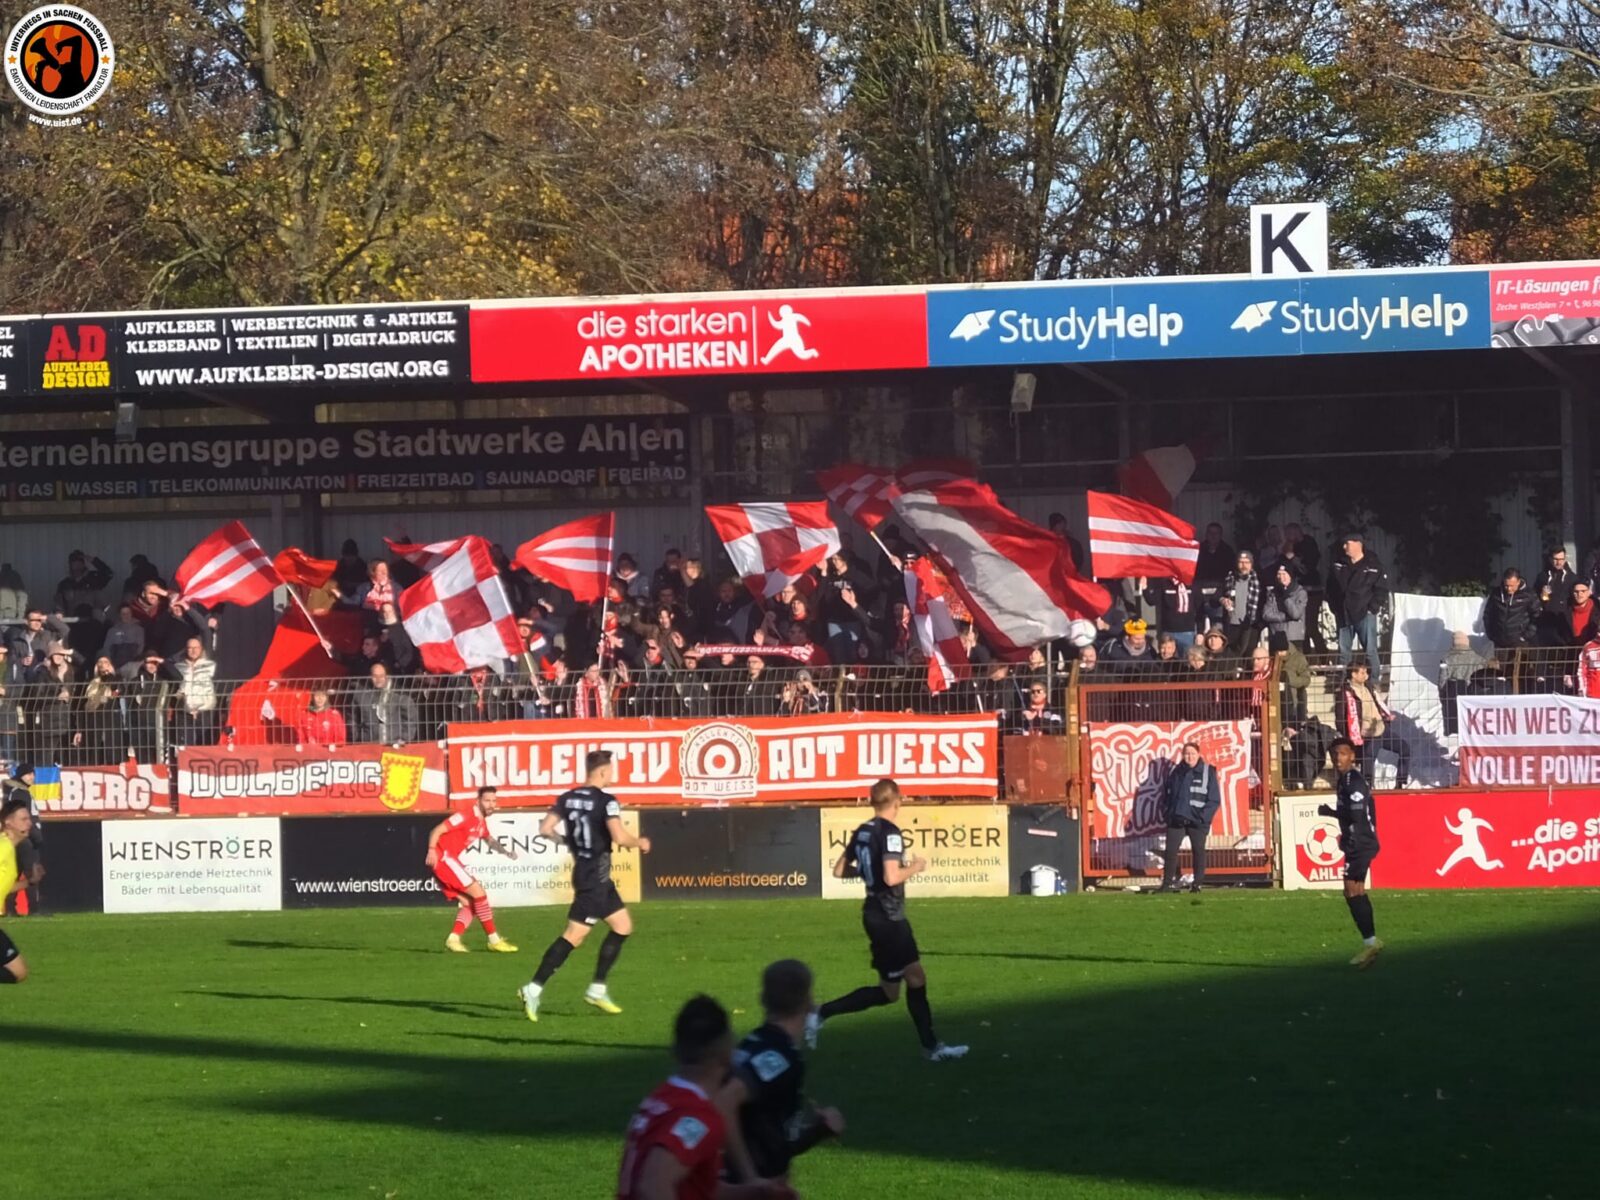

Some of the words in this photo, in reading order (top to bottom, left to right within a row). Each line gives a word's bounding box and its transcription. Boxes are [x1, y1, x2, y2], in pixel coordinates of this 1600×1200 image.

[1260, 211, 1314, 274] K
[1495, 279, 1590, 296] IT-Lösungen
[1592, 275, 1600, 294] f
[124, 319, 216, 335] AUFKLEBER
[231, 315, 358, 332] WERBETECHNIK
[362, 314, 375, 327] &
[379, 311, 457, 327] -ARTIKEL
[577, 310, 627, 339] die
[634, 307, 748, 337] starken
[999, 303, 1184, 350] StudyHelp
[1280, 293, 1468, 340] StudyHelp
[45, 324, 107, 361] AD
[126, 338, 221, 354] KLEBEBAND
[234, 334, 318, 350] TEXTILIEN
[332, 330, 456, 347] DIGITALDRUCK
[43, 361, 109, 372] AUFKLEBER
[578, 340, 748, 372] APOTHEKEN
[42, 371, 110, 389] DESIGN
[135, 360, 450, 386] WWW.AUFKLEBER-DESIGN.ORG
[352, 426, 565, 458] Stadtwerke
[578, 422, 685, 453] Ahlen
[18, 482, 54, 497] GAS
[65, 481, 138, 496] WASSER
[150, 475, 345, 494] TELEKOMMUNIKATION
[358, 471, 475, 488] FREIZEITBAD
[486, 468, 597, 486] SAUNADORF
[607, 466, 686, 484] FREIBAD
[1467, 708, 1517, 735] KEIN
[1524, 707, 1572, 735] WEG
[768, 735, 845, 780] ROT
[857, 732, 985, 775] WEISS
[189, 758, 383, 798] DOLBERG
[1467, 755, 1535, 785] VOLLE
[40, 771, 150, 811] BERG
[714, 780, 754, 791] WEISS
[829, 825, 1000, 850] WSTRÖER
[1584, 816, 1600, 837] s
[109, 836, 272, 861] WIENSTRÖER
[109, 869, 203, 881] Energiesparende
[206, 867, 272, 879] Heiztechnik
[931, 856, 1001, 868] Heiztechnik
[1309, 867, 1344, 880] AHLE
[157, 884, 175, 895] mit
[179, 883, 262, 896] Lebensqualität
[513, 879, 530, 889] mit
[655, 871, 807, 888] www.wienstroeer.de
[904, 873, 989, 884] ebensqualität
